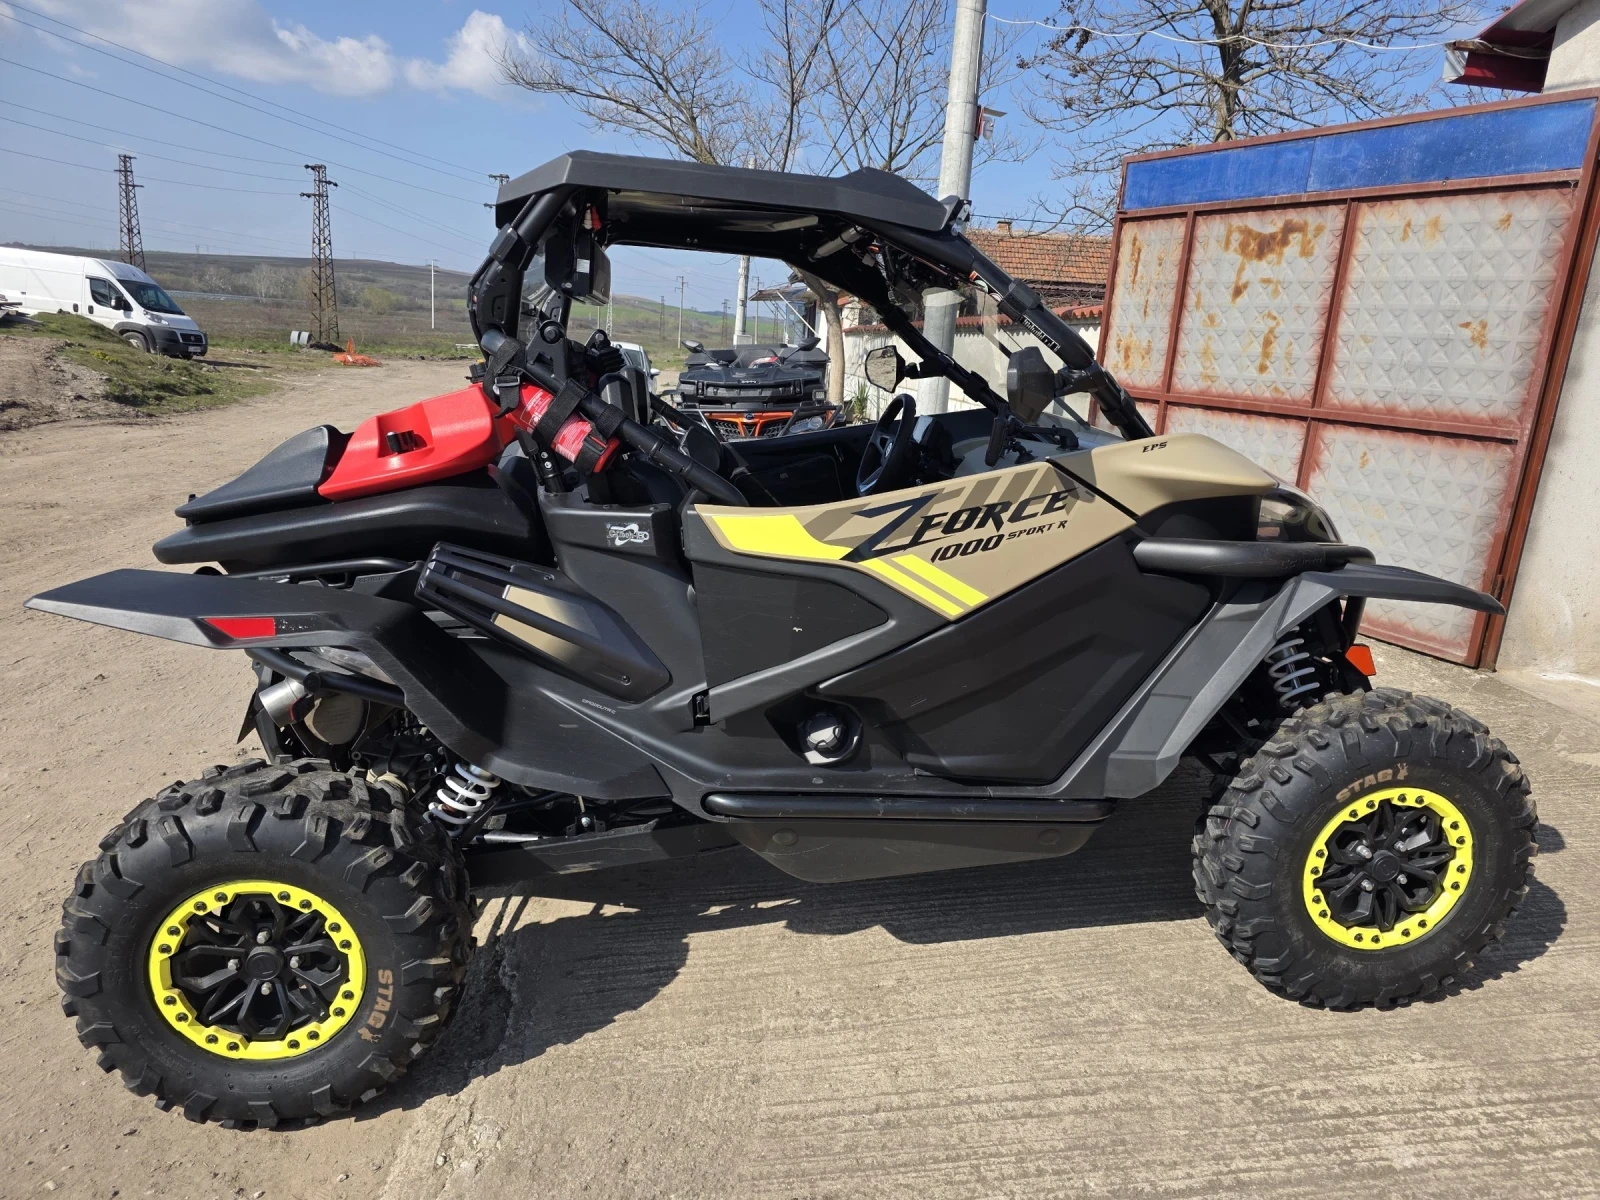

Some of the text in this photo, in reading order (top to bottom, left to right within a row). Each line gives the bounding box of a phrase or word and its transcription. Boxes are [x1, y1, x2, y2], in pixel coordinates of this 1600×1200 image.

[1142, 441, 1168, 453] EPS
[930, 519, 1069, 563] 1000 SPORT R
[1336, 768, 1393, 802] STAG
[367, 969, 394, 1029] STAG
